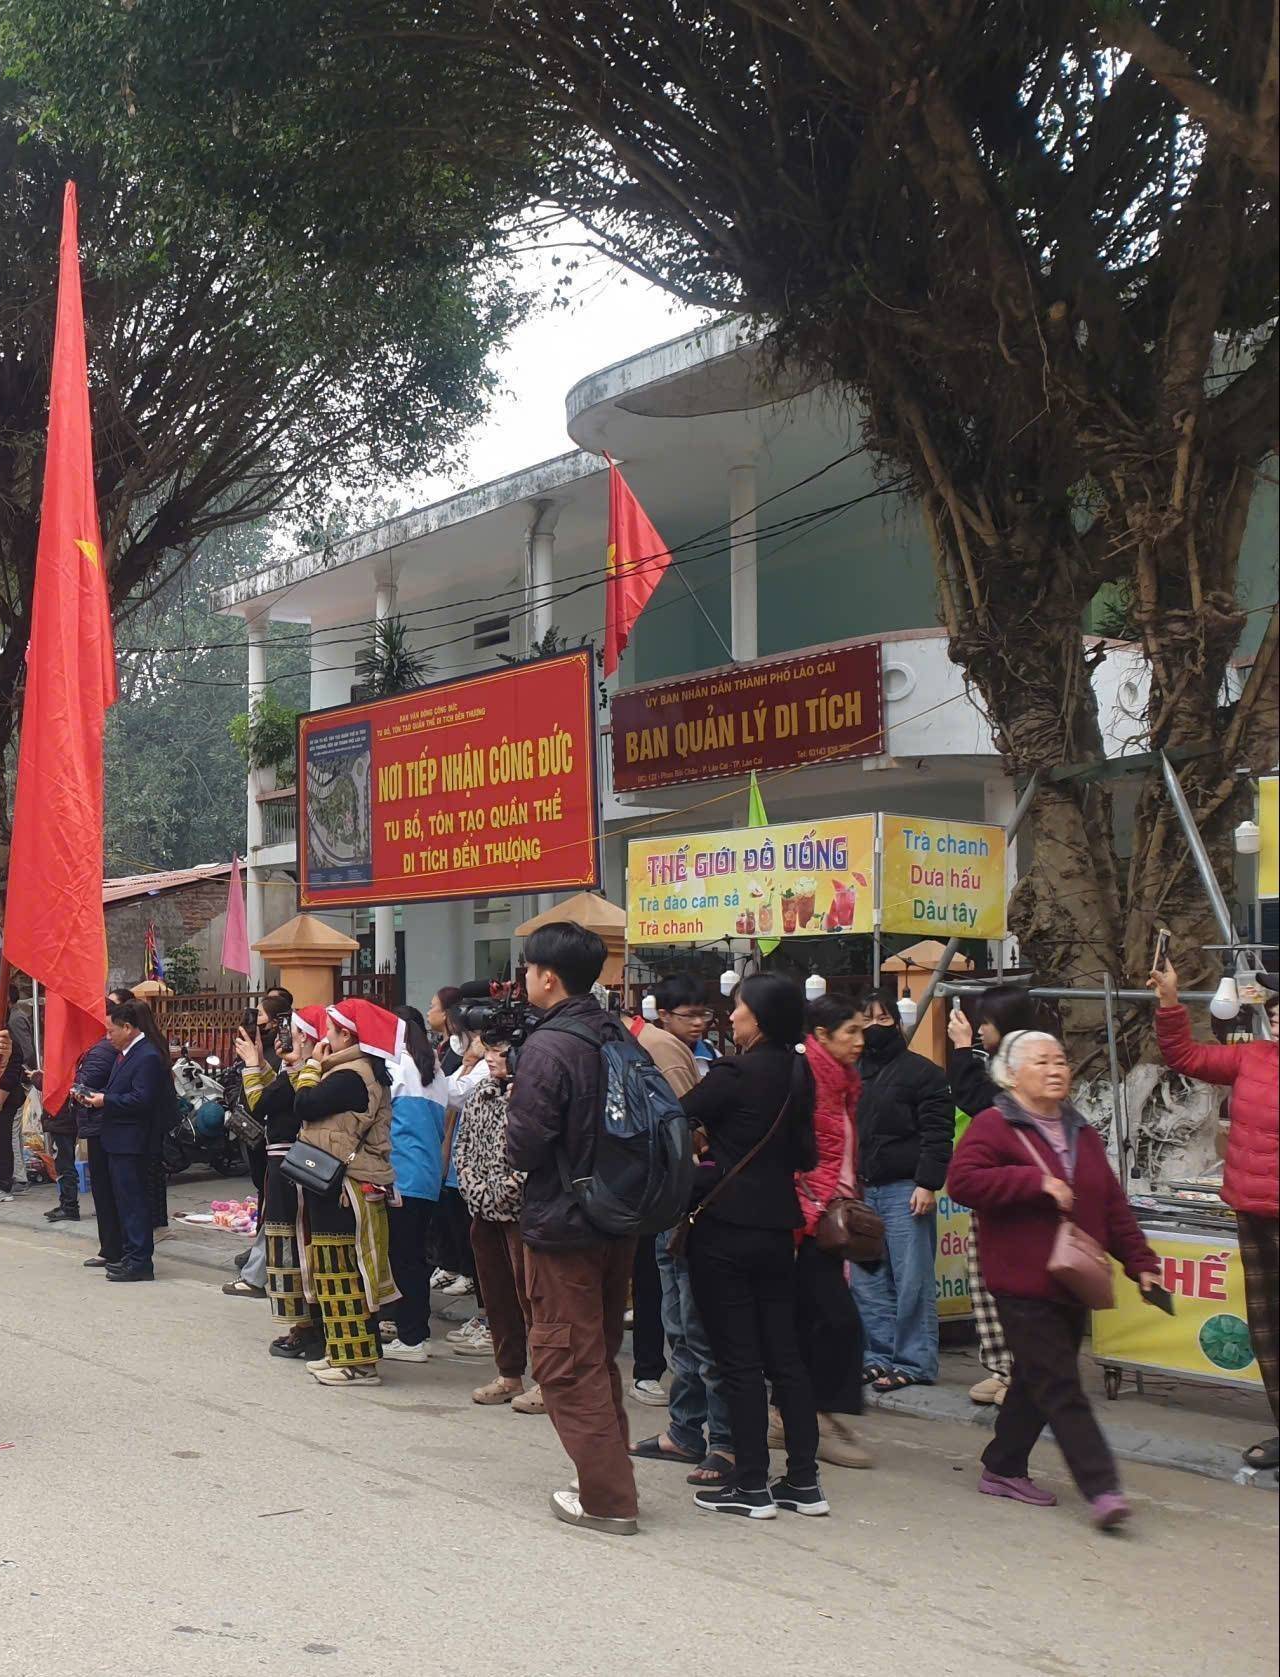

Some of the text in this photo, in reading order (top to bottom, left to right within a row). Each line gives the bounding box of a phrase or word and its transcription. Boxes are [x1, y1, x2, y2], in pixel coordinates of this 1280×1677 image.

[660, 691, 679, 705] BAN
[682, 685, 708, 701] NHÂN
[710, 681, 733, 696] DÂN
[734, 675, 768, 691] THÀNH
[770, 666, 791, 684] PHỐ
[816, 661, 836, 675] CAI
[625, 687, 862, 763] BAN QUẢN LÝ DI TÍCH
[378, 722, 573, 803] NƠI TIẾP NHẬN CÔNG ĐỨC
[384, 787, 563, 842] TU BỔ, TÔN TẠO QUẦN THỂ
[403, 852, 415, 874] DI
[420, 845, 449, 872] TÍCH
[484, 836, 542, 869] THƯỢNG
[647, 829, 849, 887] THẾ GIỚI ĐỒ UỐNG
[903, 830, 989, 856] Trà chanh
[910, 864, 981, 889] Dưa hấu
[639, 889, 740, 912] Trà đào cam sả
[913, 899, 978, 928] Dâu tây
[638, 918, 704, 936] Trà chanh
[939, 1196, 968, 1220] qu
[1154, 1252, 1231, 1301] HẾ
